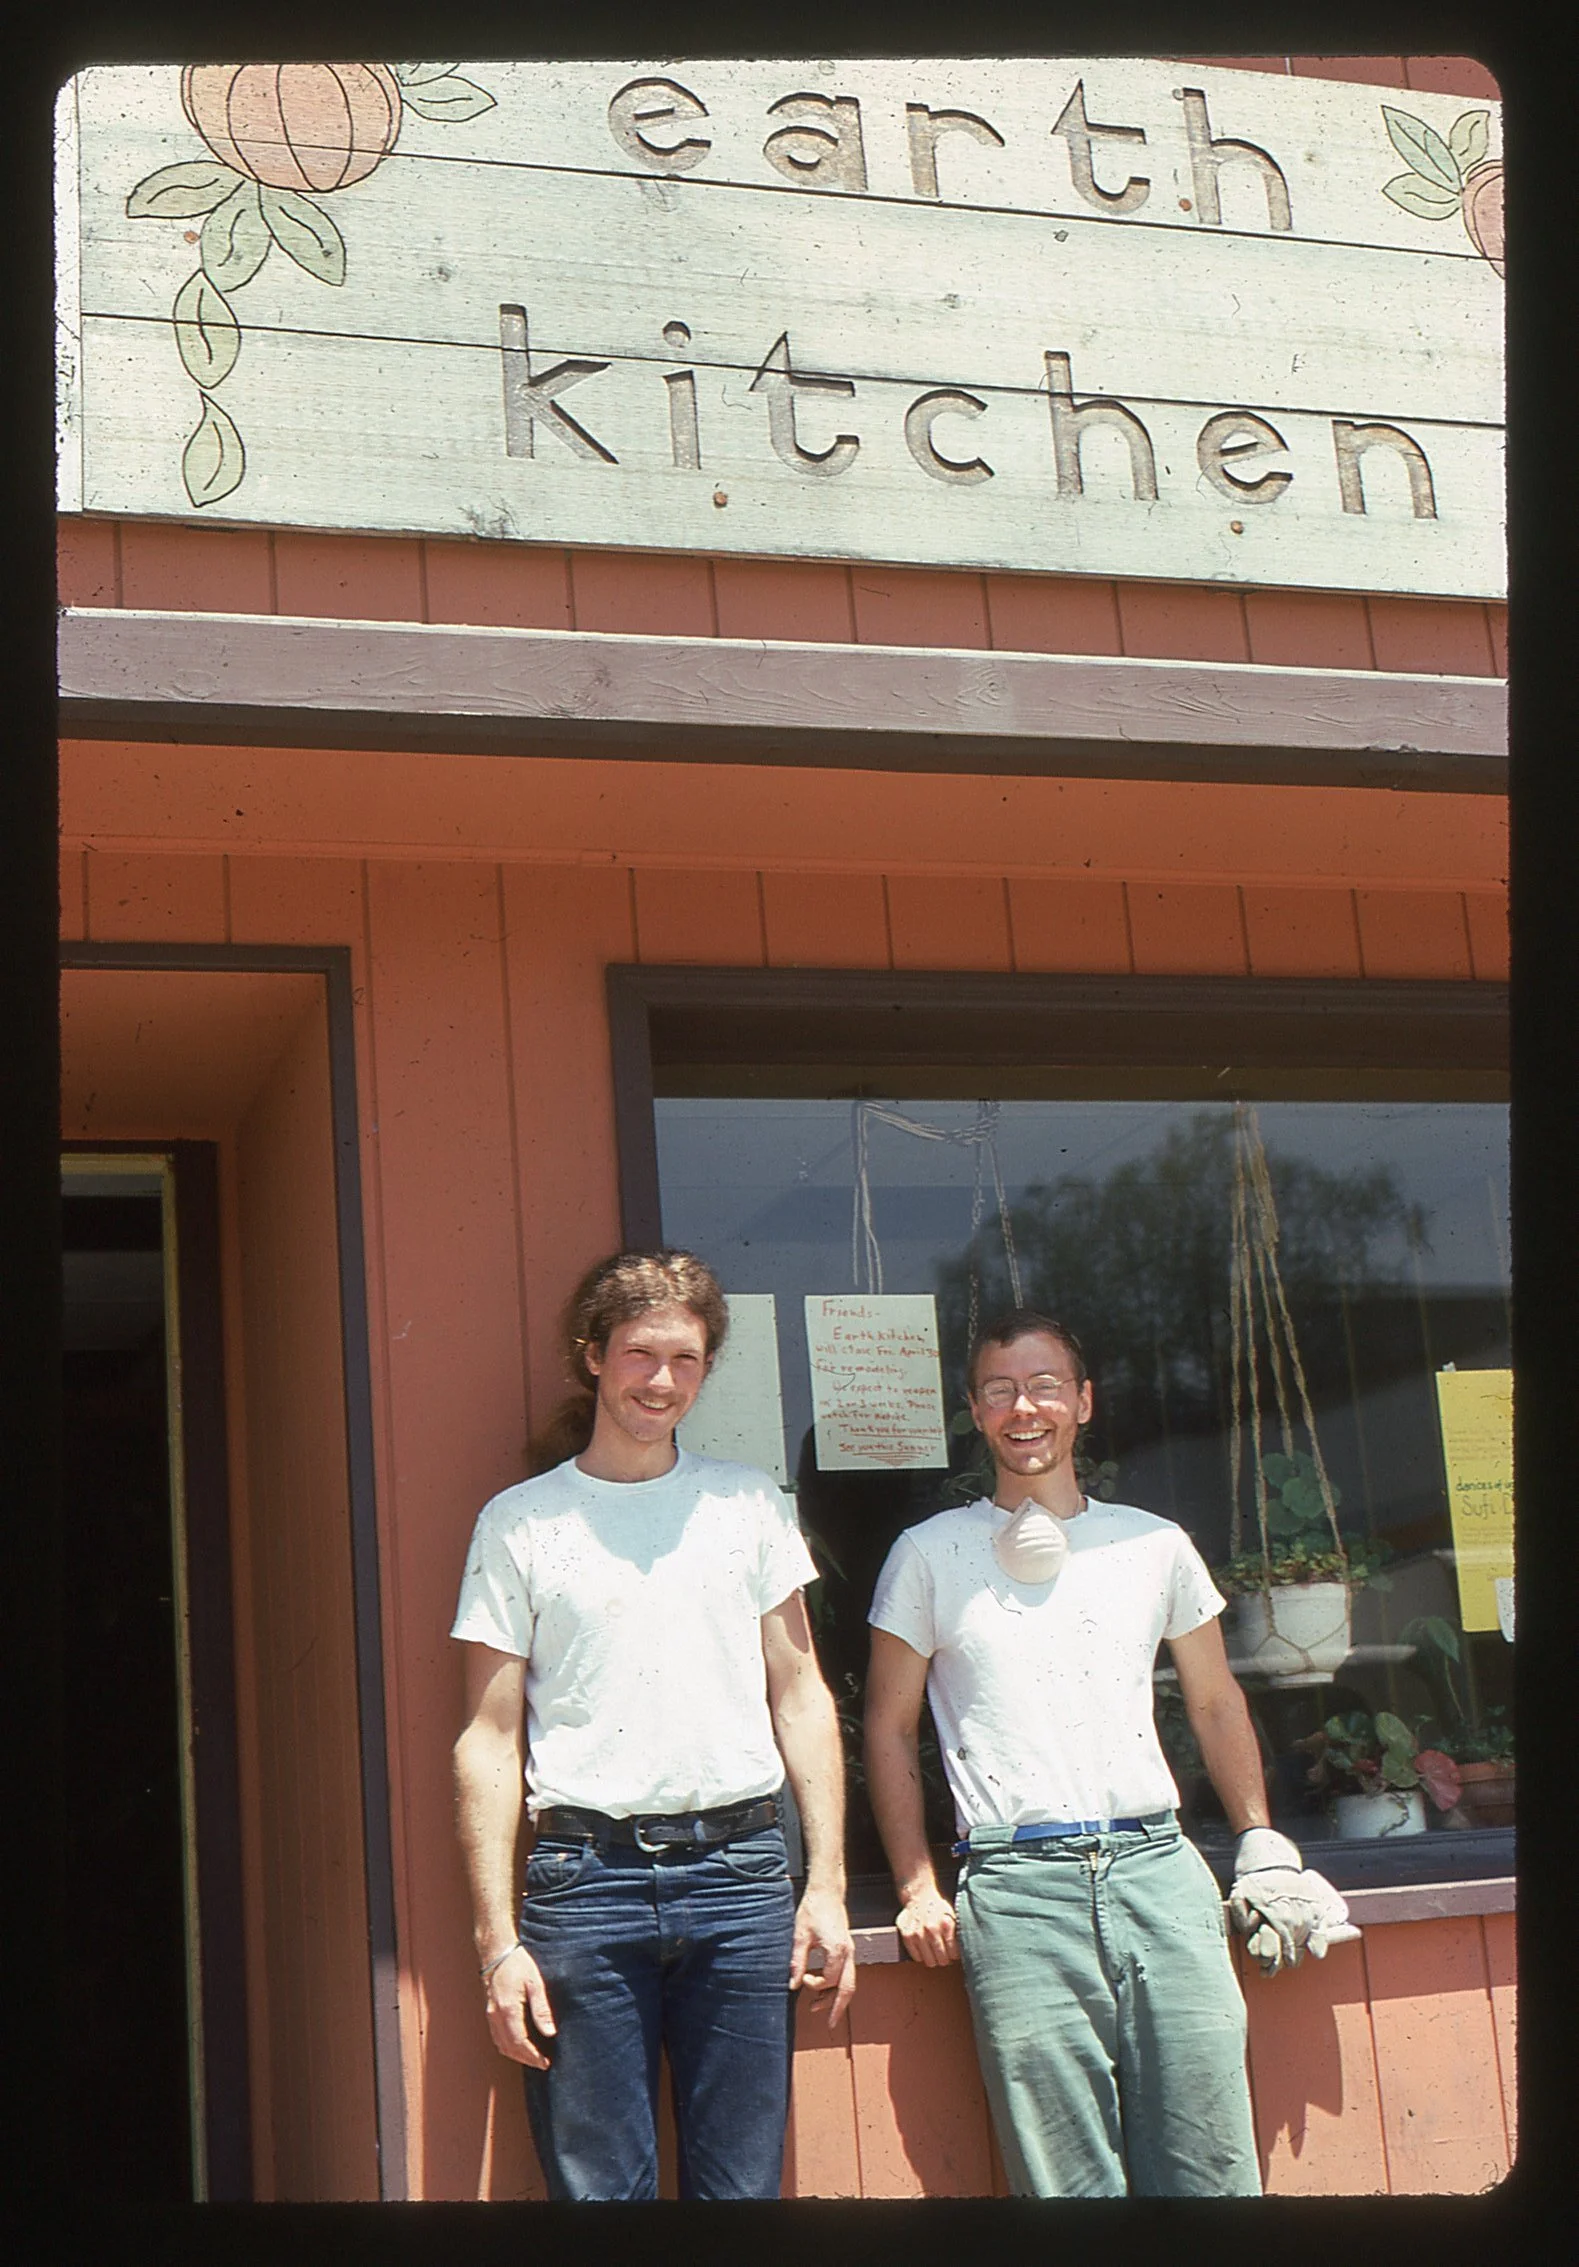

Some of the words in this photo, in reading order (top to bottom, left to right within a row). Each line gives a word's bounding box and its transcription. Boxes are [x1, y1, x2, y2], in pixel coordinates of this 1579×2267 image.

[606, 76, 1295, 234] earth
[498, 300, 1440, 522] kitchen
[851, 1383, 882, 1396] expect
[886, 1384, 898, 1394] to
